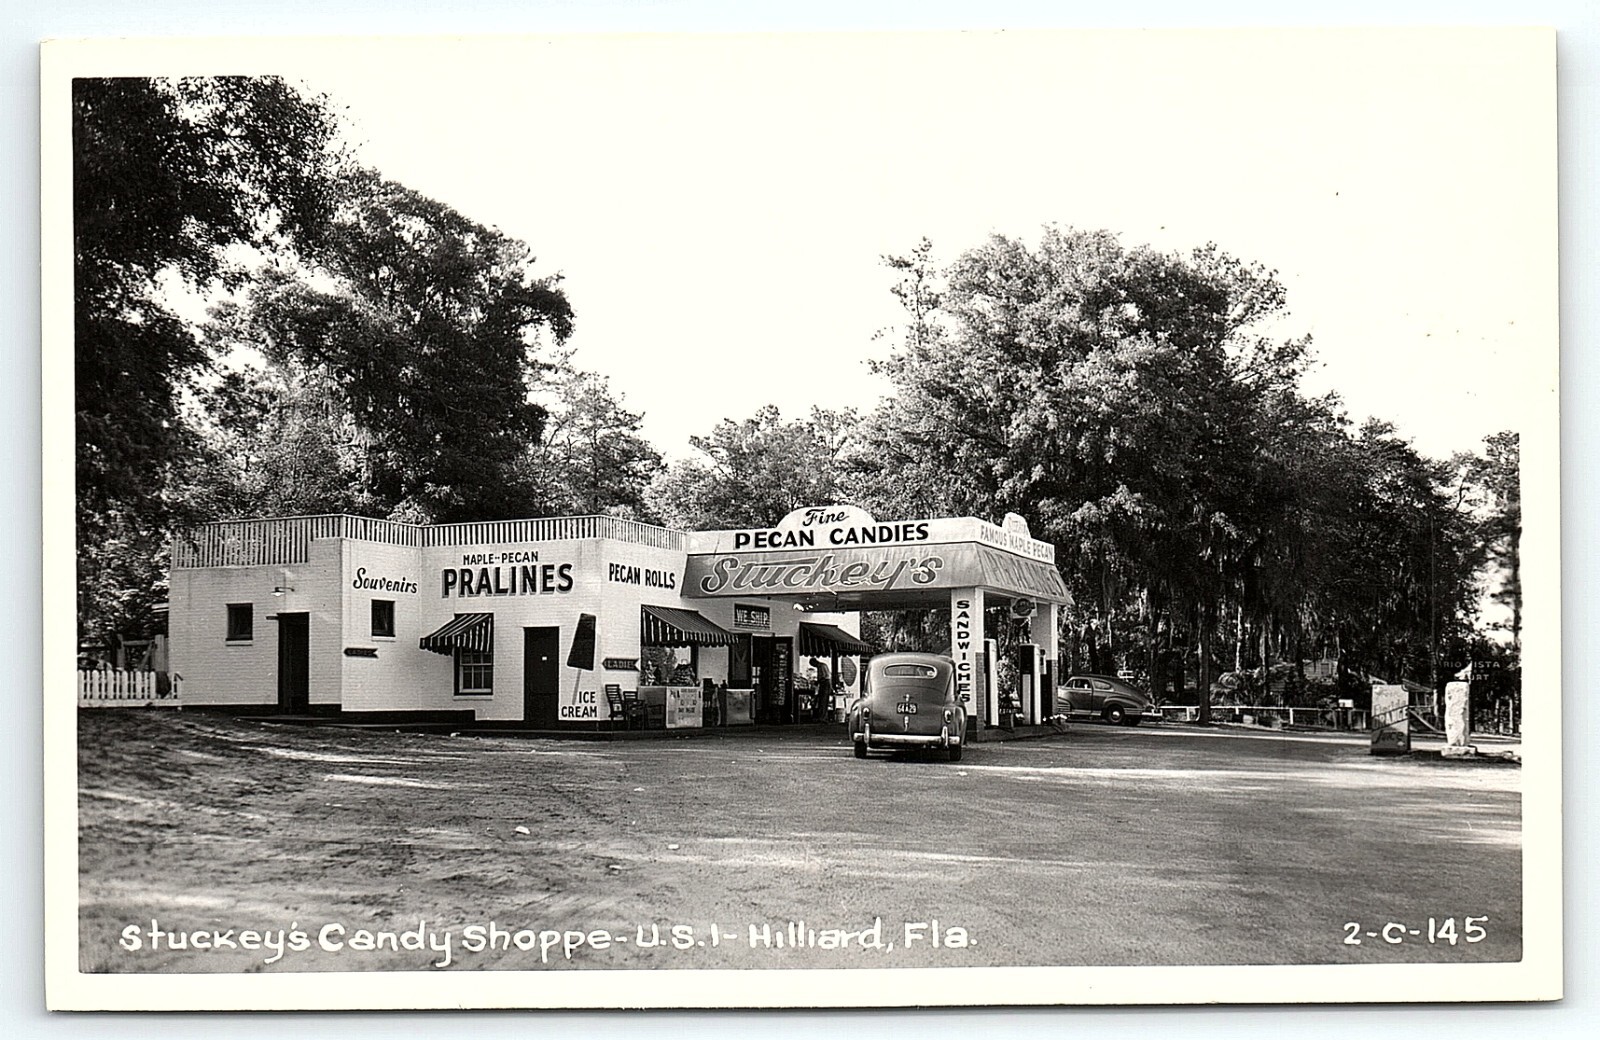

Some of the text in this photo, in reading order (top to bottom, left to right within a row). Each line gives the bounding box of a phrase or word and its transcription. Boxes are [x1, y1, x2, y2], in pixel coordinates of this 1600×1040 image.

[802, 507, 850, 527] Fine
[734, 523, 930, 550] PECAN CANDIES
[980, 525, 1007, 546] FAMOUS
[1009, 534, 1031, 555] MAPLE
[1033, 542, 1054, 561] PECAN
[352, 567, 418, 595] Souvenirs
[441, 563, 574, 598] PRALINES
[608, 562, 677, 590] PECAN ROLLS
[699, 553, 943, 595] Stuckey's
[736, 608, 769, 625] WE SHIP
[578, 690, 597, 705] ICE
[561, 704, 598, 719] CREAM
